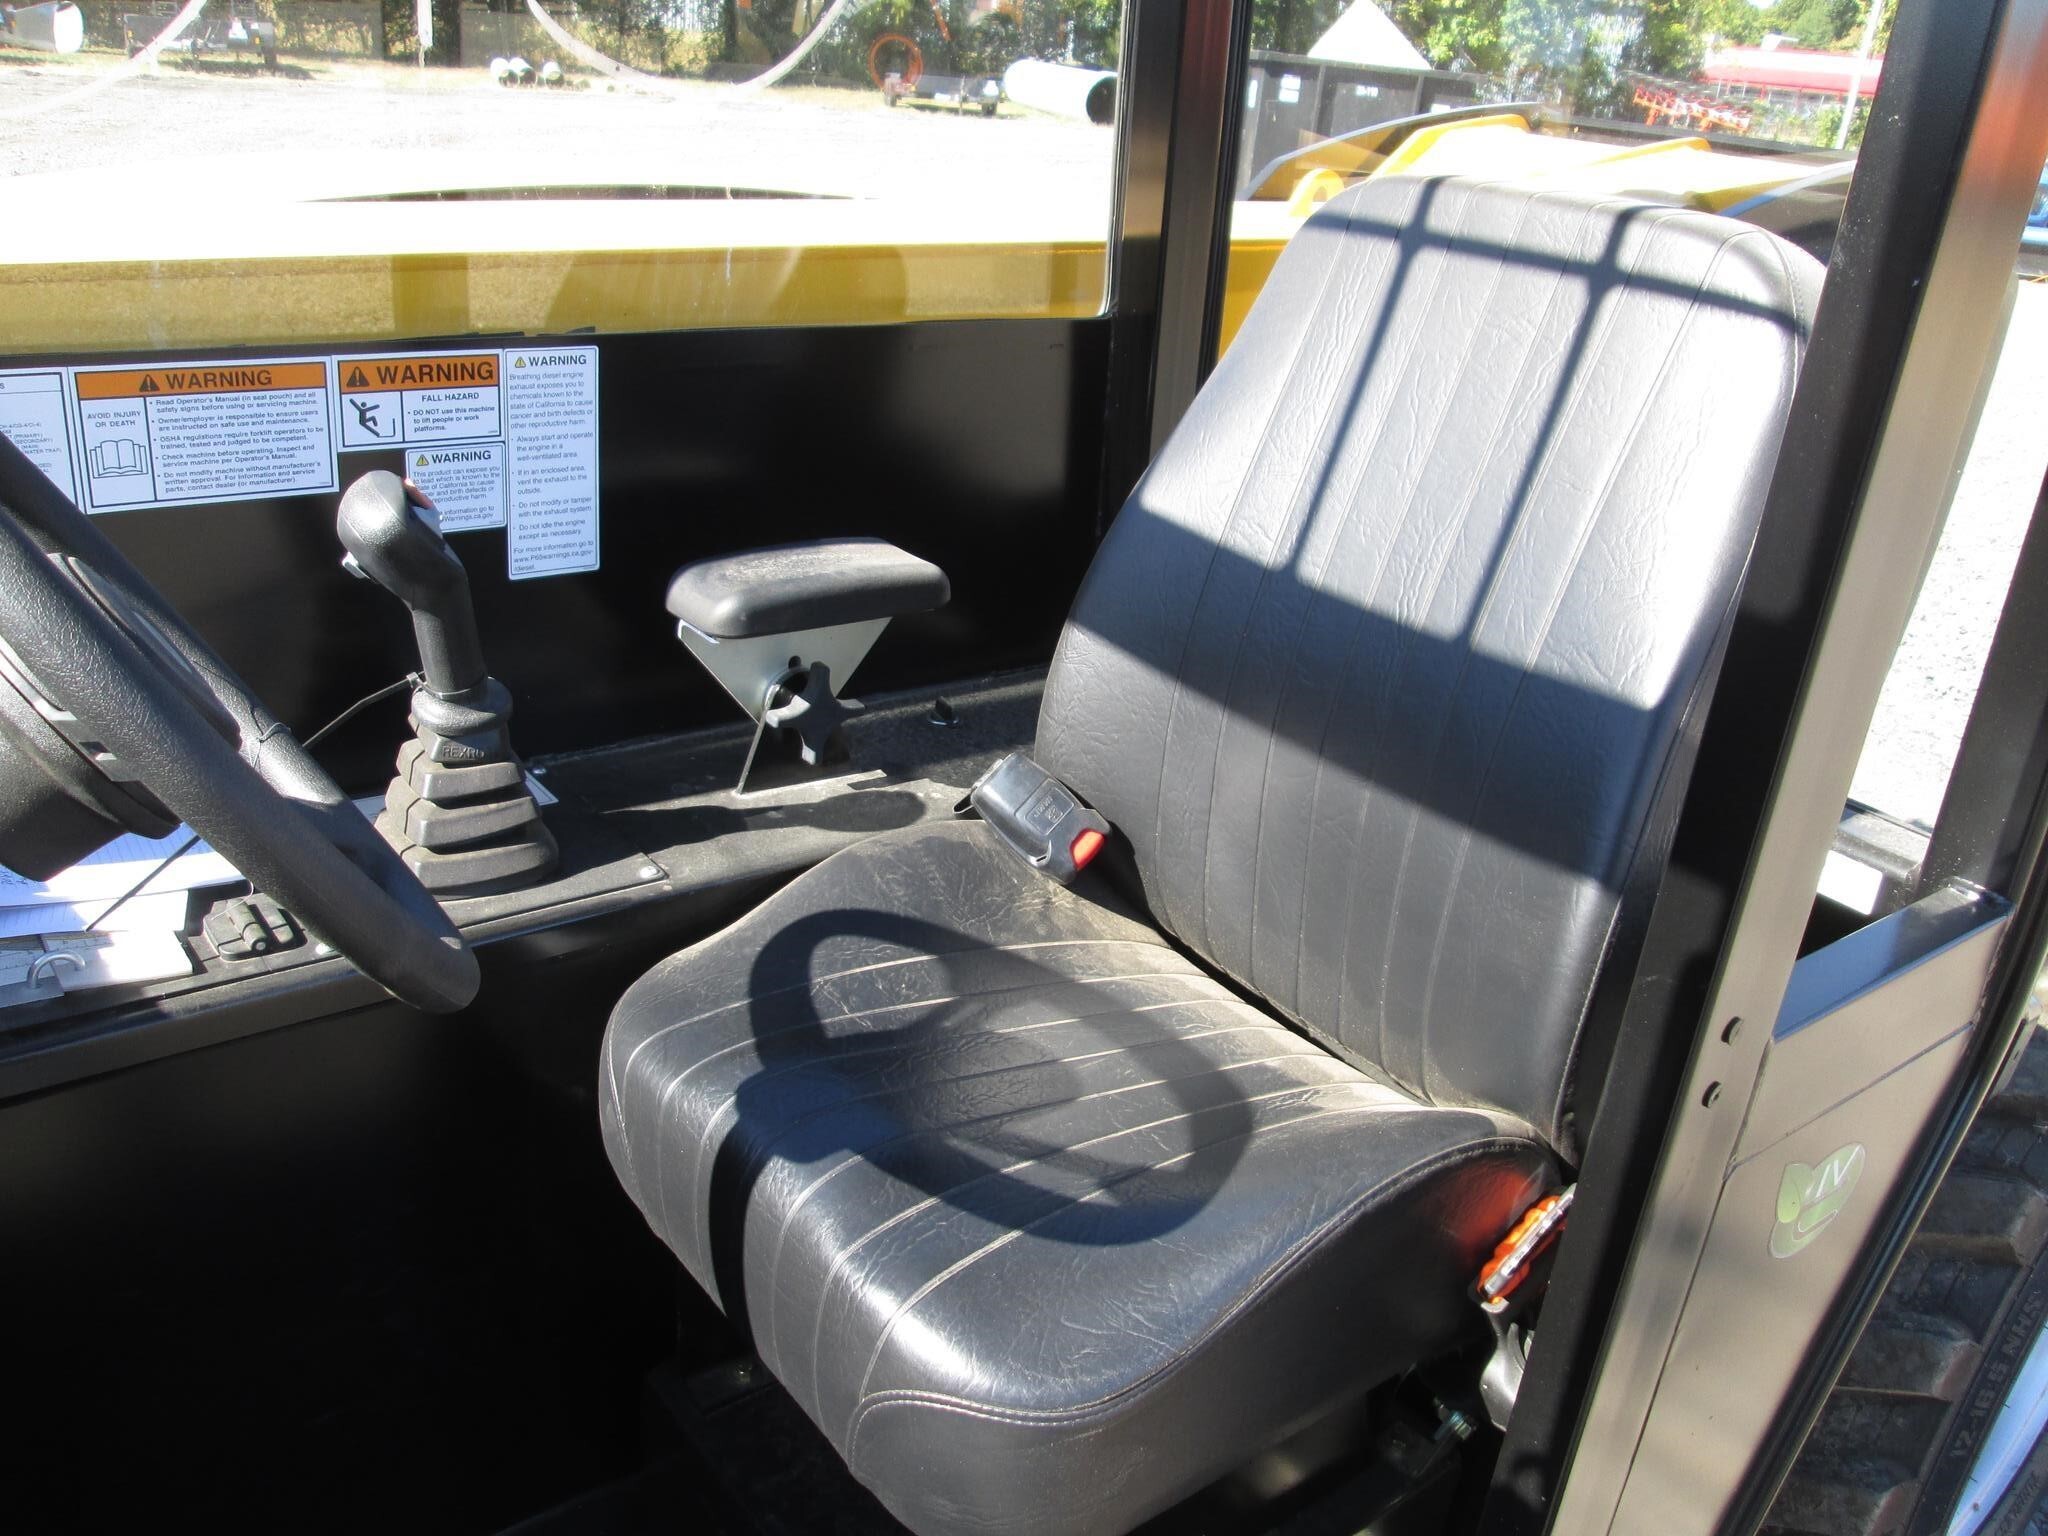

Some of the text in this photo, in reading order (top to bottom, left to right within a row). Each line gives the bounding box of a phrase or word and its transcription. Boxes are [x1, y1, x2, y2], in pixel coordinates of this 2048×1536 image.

[528, 355, 587, 367] WARNING
[376, 361, 494, 384] WARNING
[165, 370, 272, 389] WARNING
[269, 393, 292, 401] pouch)
[421, 392, 480, 402] FALL HAZARD
[226, 412, 265, 420] responsible
[183, 433, 222, 441] regulations
[274, 427, 306, 436] operators
[227, 438, 251, 446] judged
[431, 451, 491, 464] WARNING
